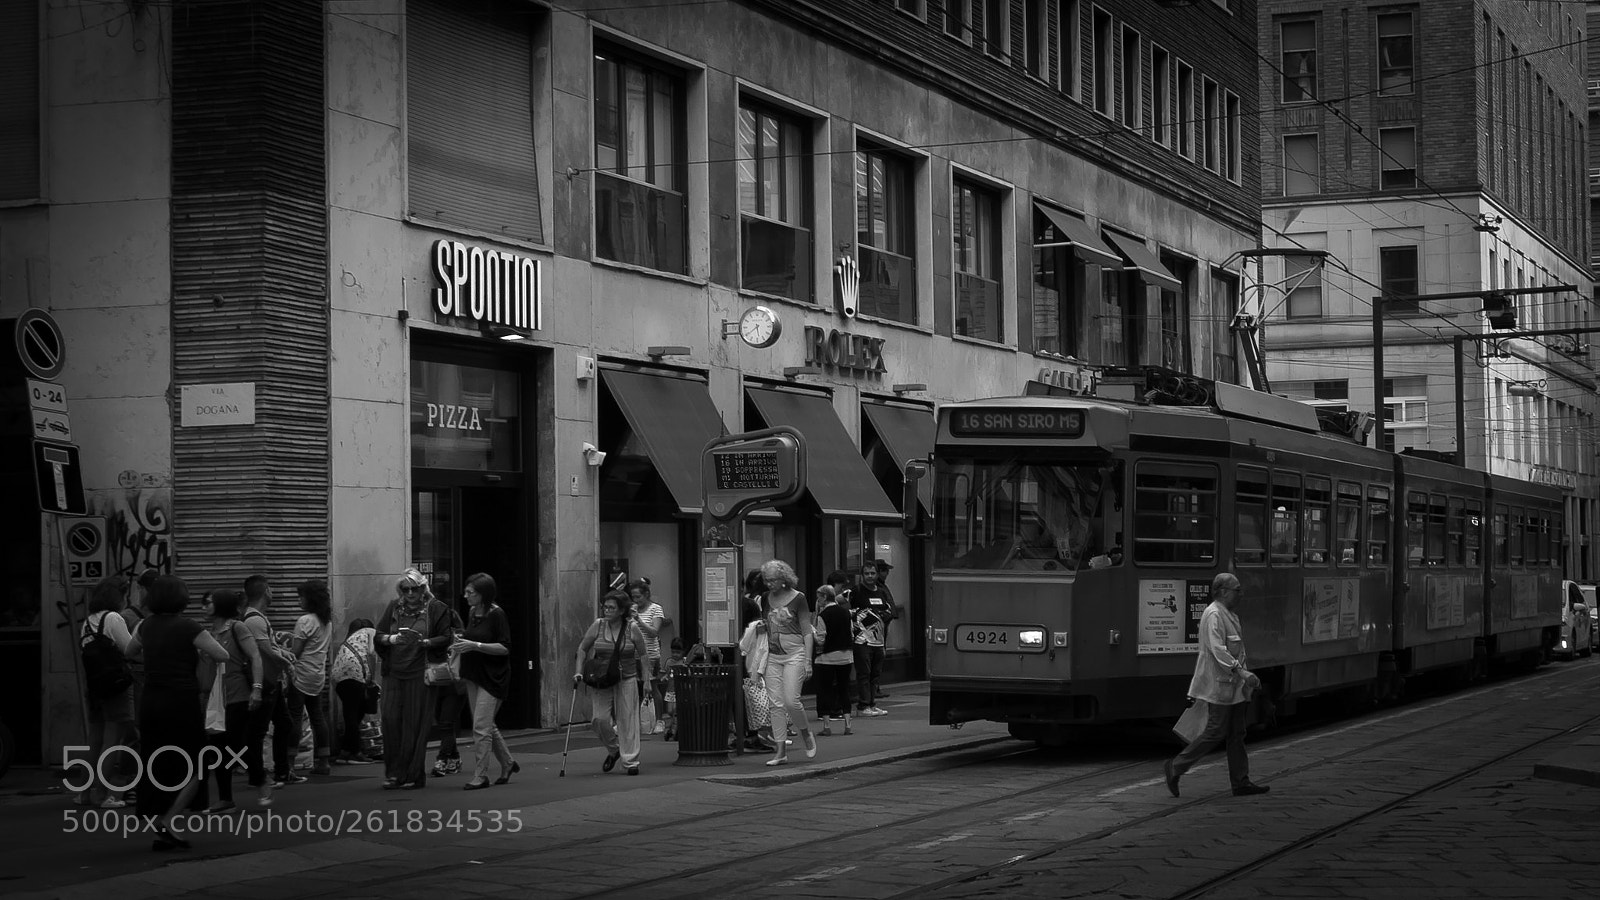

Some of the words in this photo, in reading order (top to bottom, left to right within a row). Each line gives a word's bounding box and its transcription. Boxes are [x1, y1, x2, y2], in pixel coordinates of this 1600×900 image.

[431, 238, 542, 331] SPONTINI
[804, 325, 888, 374] ROLEX
[210, 387, 225, 395] VIA
[196, 404, 240, 415] DOGANA
[426, 403, 482, 431] PIZZA
[961, 413, 980, 429] 16
[983, 413, 1013, 428] SAN
[1018, 413, 1055, 428] SIRO
[1059, 413, 1080, 429] M5
[966, 630, 1008, 645] 4924
